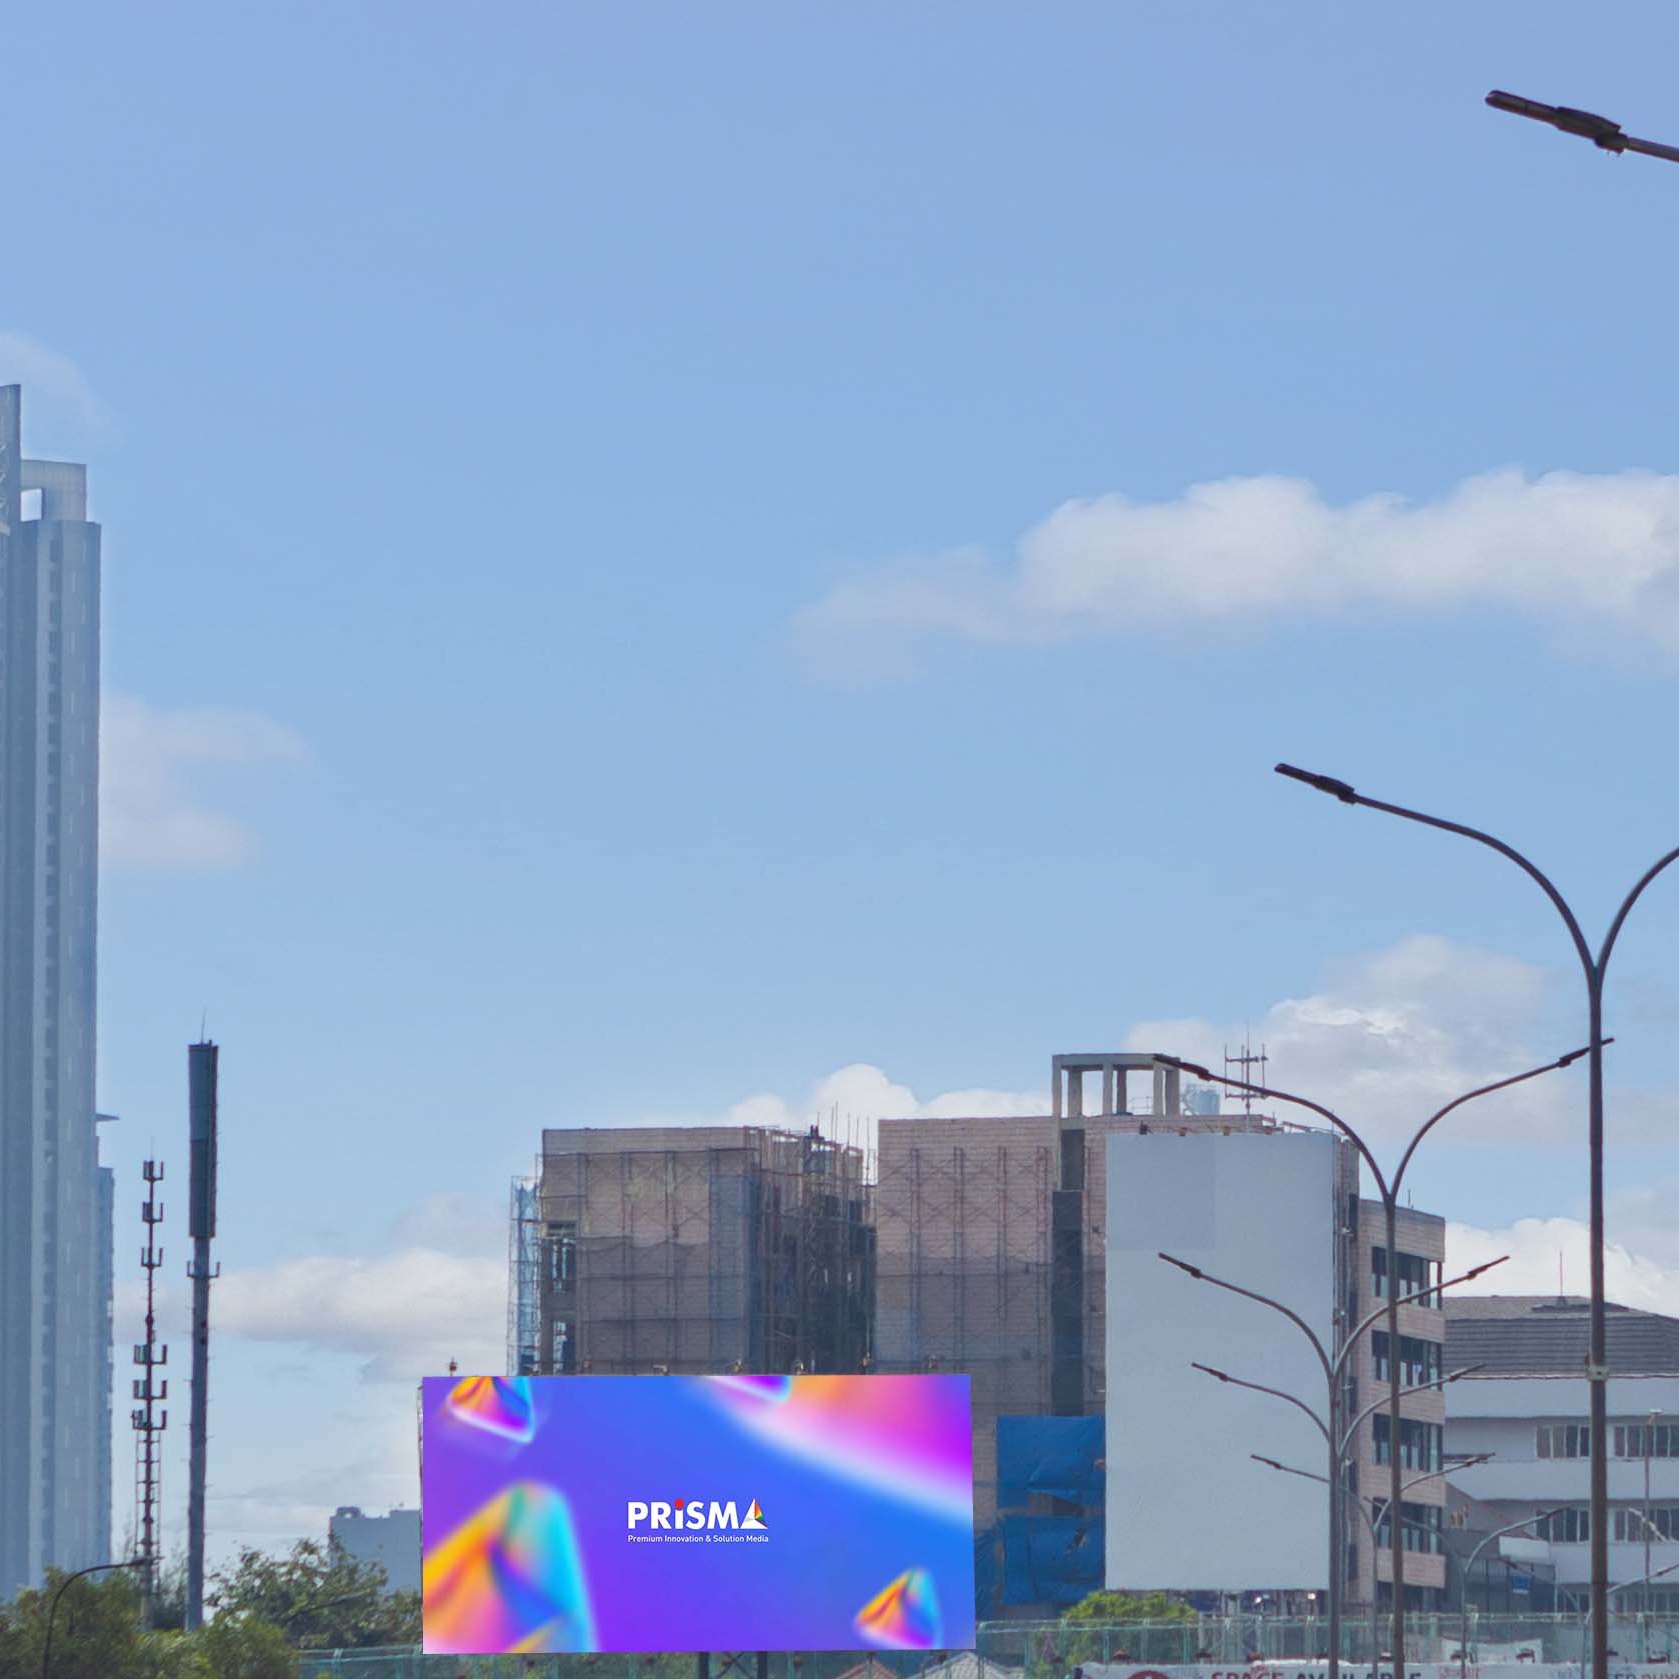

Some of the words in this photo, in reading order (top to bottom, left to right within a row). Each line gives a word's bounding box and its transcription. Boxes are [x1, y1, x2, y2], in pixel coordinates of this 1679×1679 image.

[628, 1534, 662, 1542] Premium
[664, 1534, 703, 1542] Innovation
[705, 1534, 711, 1542] &
[713, 1534, 744, 1542] Solution
[746, 1534, 769, 1542] Media
